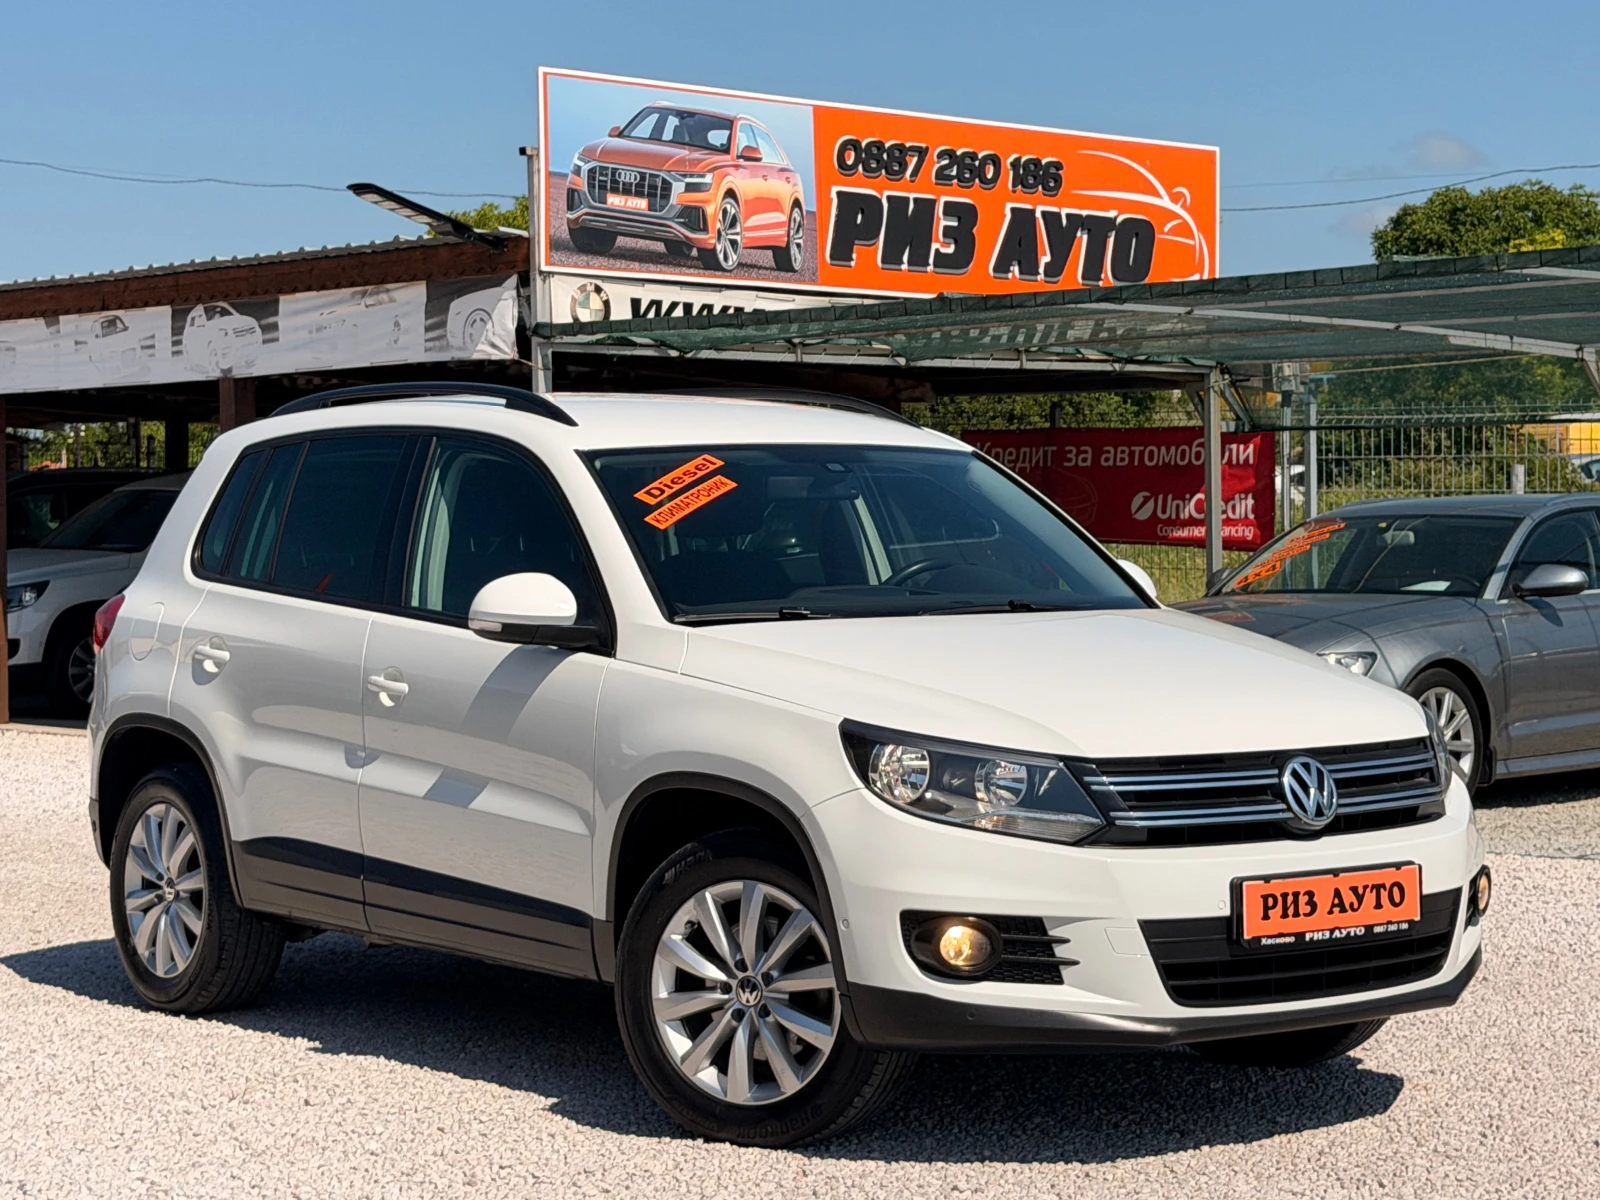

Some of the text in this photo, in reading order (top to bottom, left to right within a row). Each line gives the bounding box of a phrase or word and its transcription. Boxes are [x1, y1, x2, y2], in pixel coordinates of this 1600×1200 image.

[835, 136, 1065, 198] 0887 260 186
[828, 187, 1156, 286] РИЗ АУТО
[1063, 449, 1092, 467] за
[1100, 438, 1254, 468] автомобли
[643, 457, 718, 499] Diesel
[650, 477, 731, 525] КЛИМАТРОНИК
[1156, 492, 1255, 520] UniCedit
[1220, 523, 1254, 540] ancing
[1260, 880, 1406, 921] РИЗ АУТО
[1305, 931, 1330, 941] РИЗ
[1332, 926, 1365, 939] АУТО
